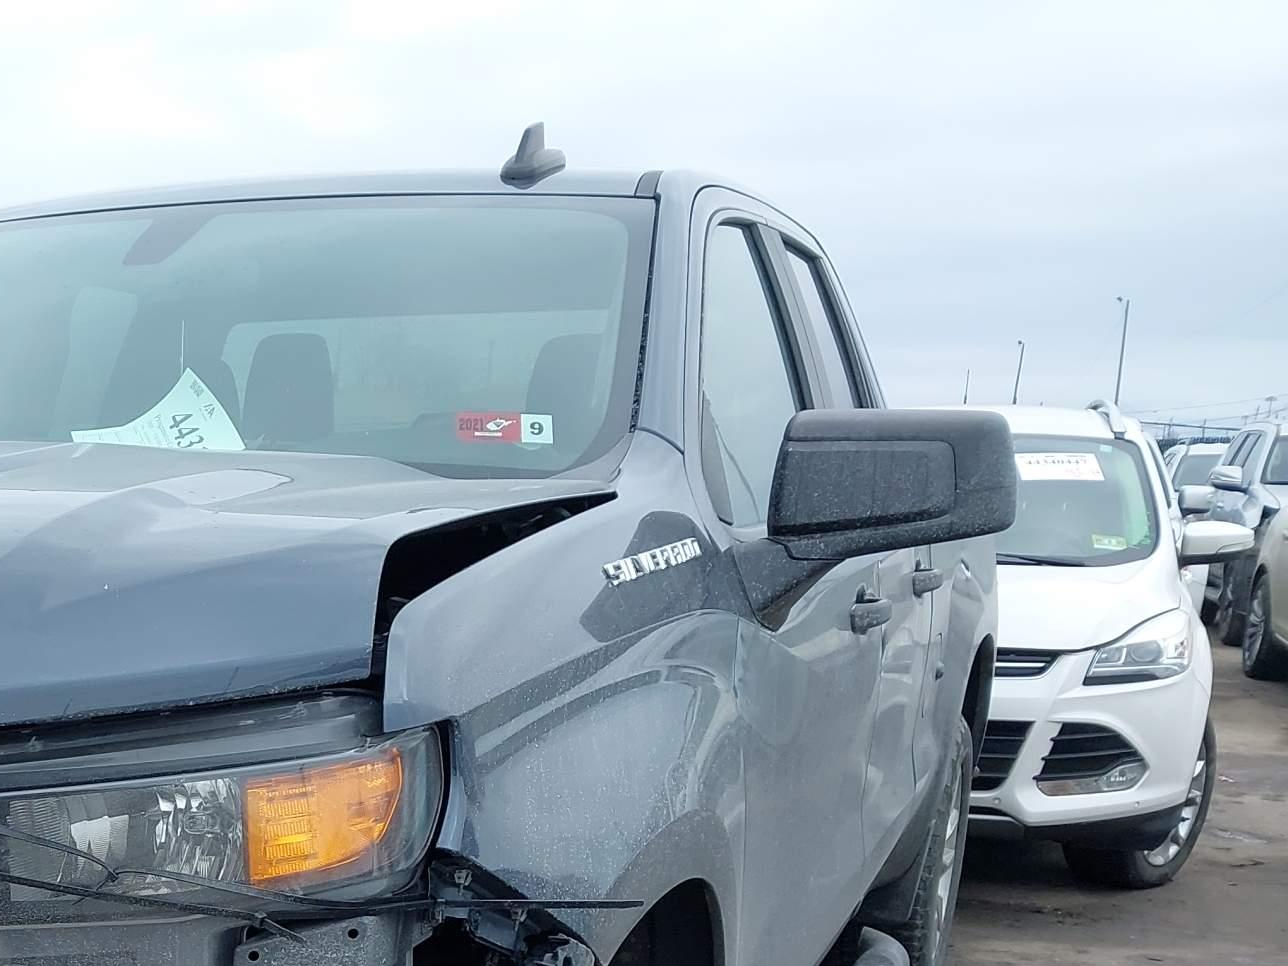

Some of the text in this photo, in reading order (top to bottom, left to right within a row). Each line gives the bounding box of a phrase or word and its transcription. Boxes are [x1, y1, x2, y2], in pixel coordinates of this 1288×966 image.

[169, 413, 209, 450] 443
[458, 418, 484, 431] 2021
[529, 421, 544, 436] 9
